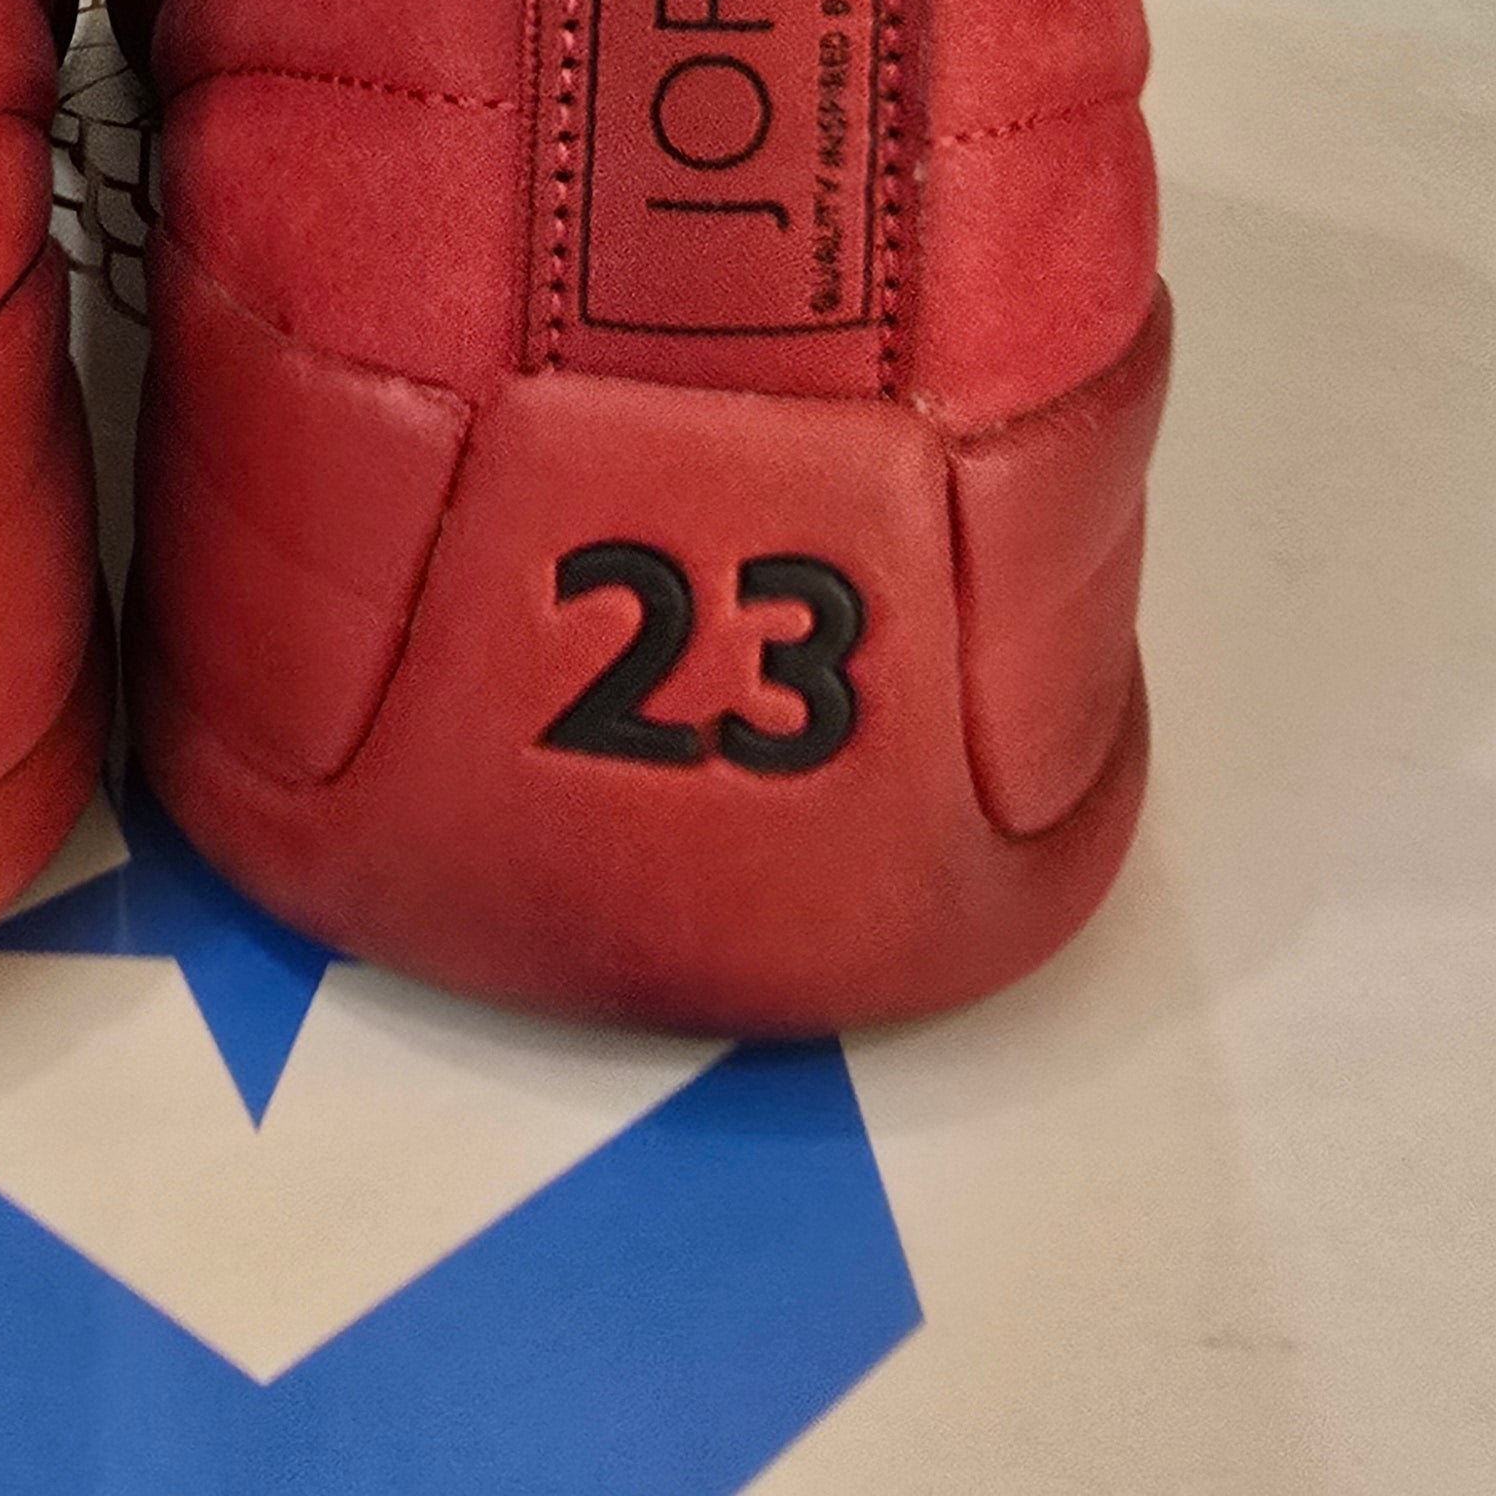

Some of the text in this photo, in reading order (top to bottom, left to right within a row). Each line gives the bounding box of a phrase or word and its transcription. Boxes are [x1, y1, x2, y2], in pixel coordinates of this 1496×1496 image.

[816, 31, 851, 169] INSPIRED
[809, 174, 844, 315] QUALITY
[533, 538, 869, 780] 23
